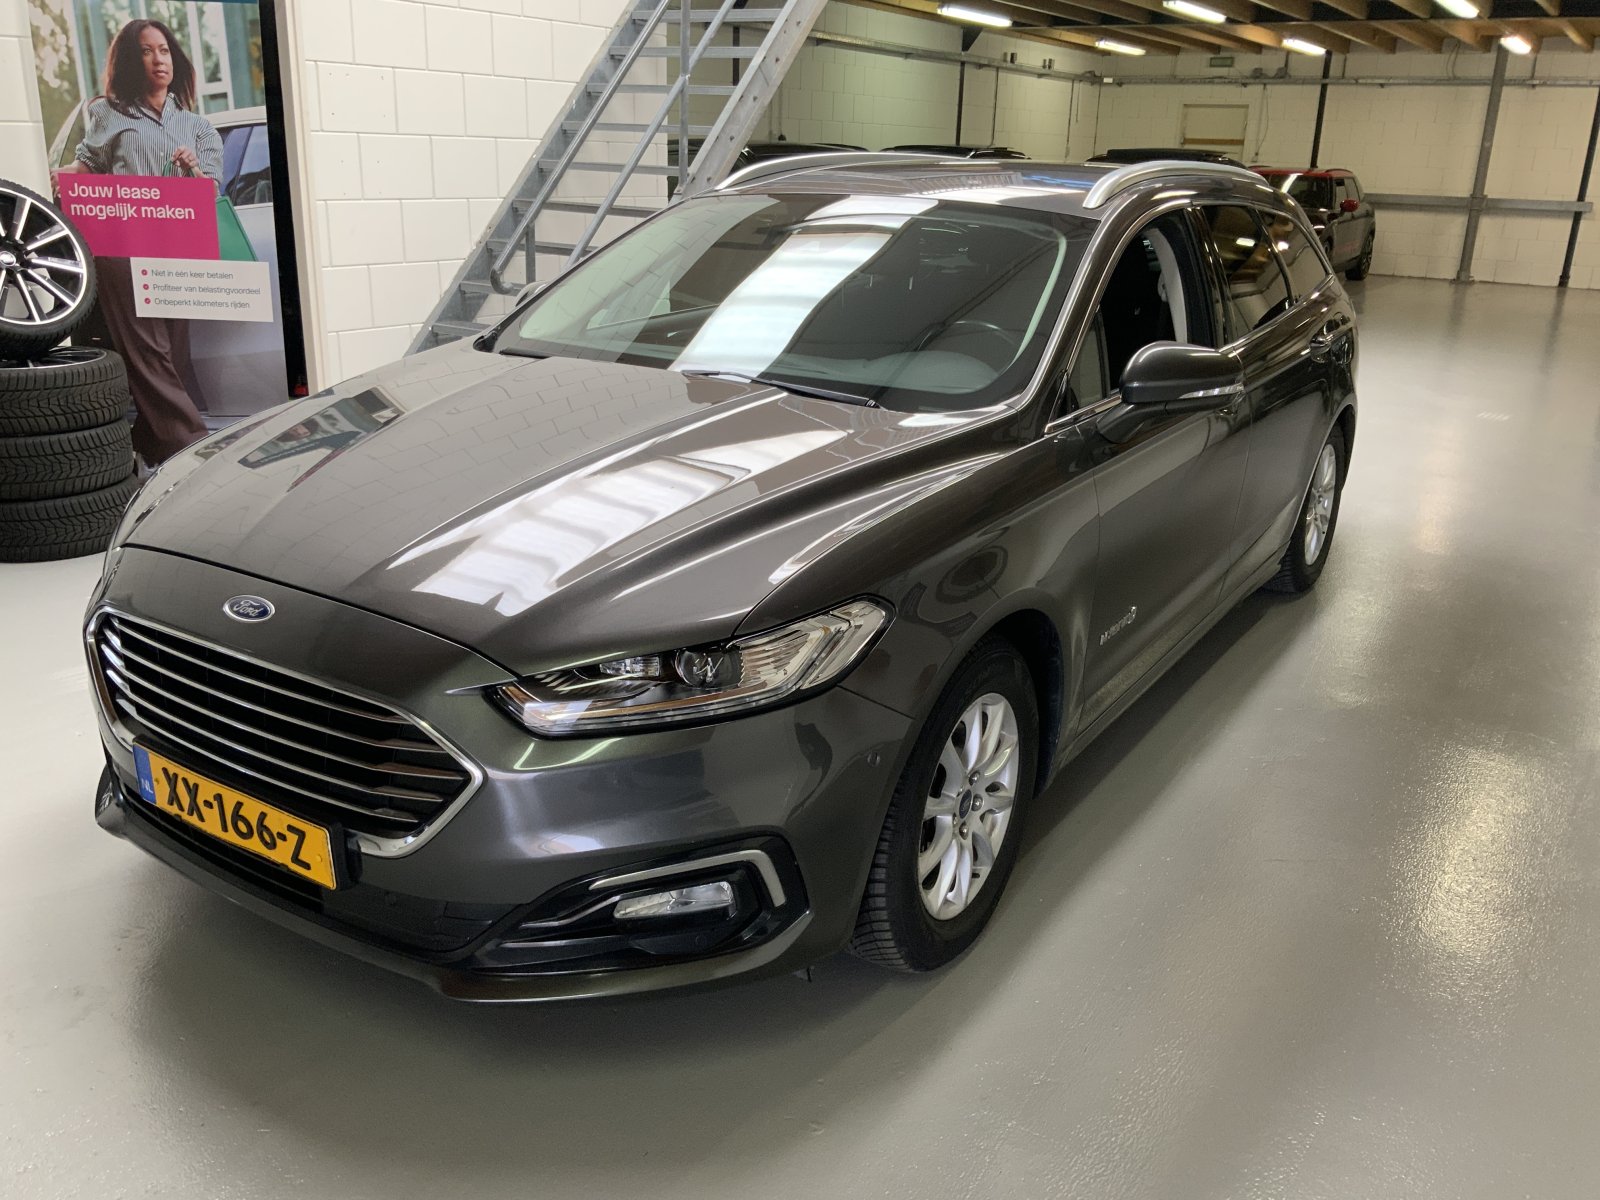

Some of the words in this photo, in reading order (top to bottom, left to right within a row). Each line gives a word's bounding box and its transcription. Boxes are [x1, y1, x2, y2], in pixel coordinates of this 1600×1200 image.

[69, 183, 113, 198] Jouw
[117, 184, 161, 200] lease
[70, 203, 138, 220] mogelijk
[141, 205, 195, 220] maken
[151, 269, 165, 277] Niet
[167, 270, 174, 278] in
[190, 270, 205, 279] keer
[207, 272, 234, 280] betalen
[152, 284, 183, 293] Profiteer
[198, 285, 261, 295] belastingvoordeel
[154, 298, 191, 308] Onbeperkt
[193, 299, 230, 308] kilometers
[230, 301, 250, 310] rijden
[141, 778, 154, 794] NL
[161, 767, 311, 871] XX-166-Z
